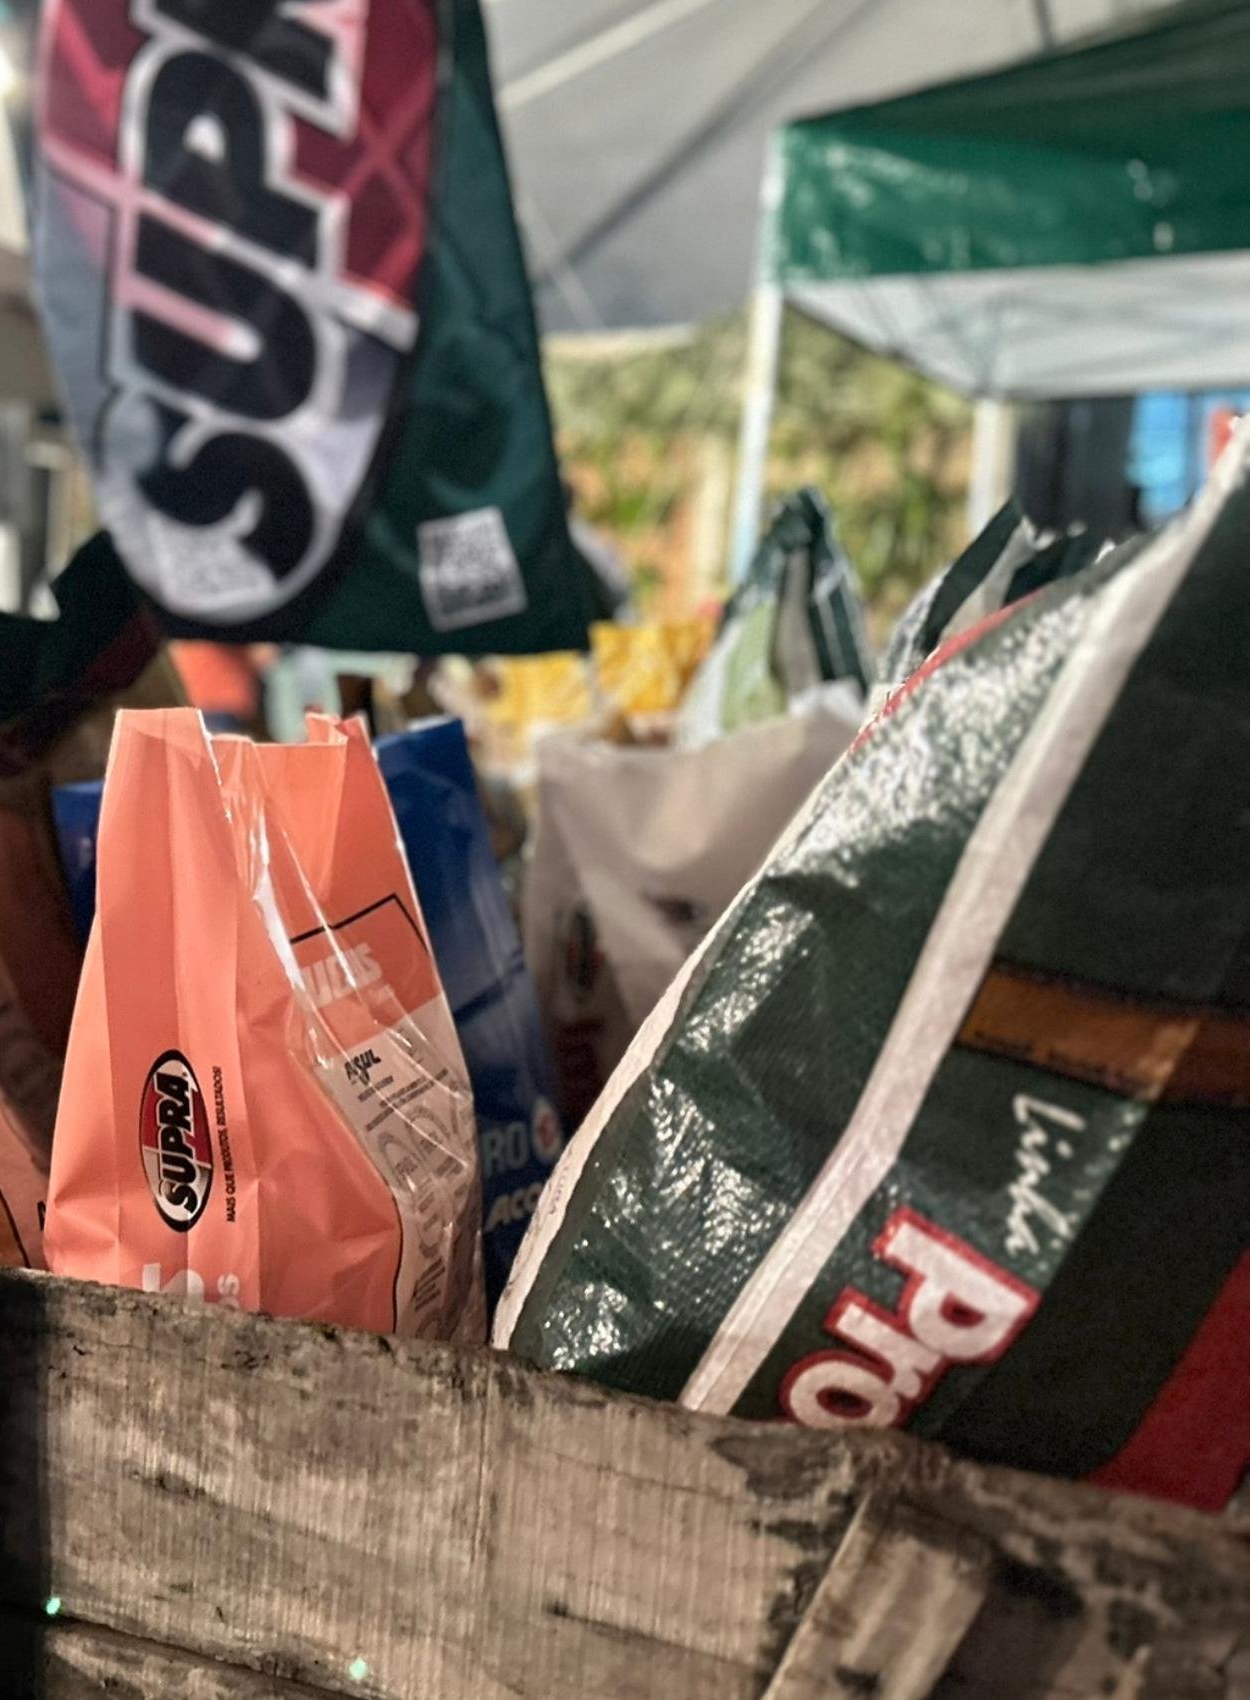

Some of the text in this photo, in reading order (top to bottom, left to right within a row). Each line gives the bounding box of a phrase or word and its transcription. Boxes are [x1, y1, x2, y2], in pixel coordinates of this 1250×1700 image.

[155, 1071, 199, 1215] SUPRA
[224, 1173, 236, 1195] QUE
[226, 1196, 236, 1222] MAIS
